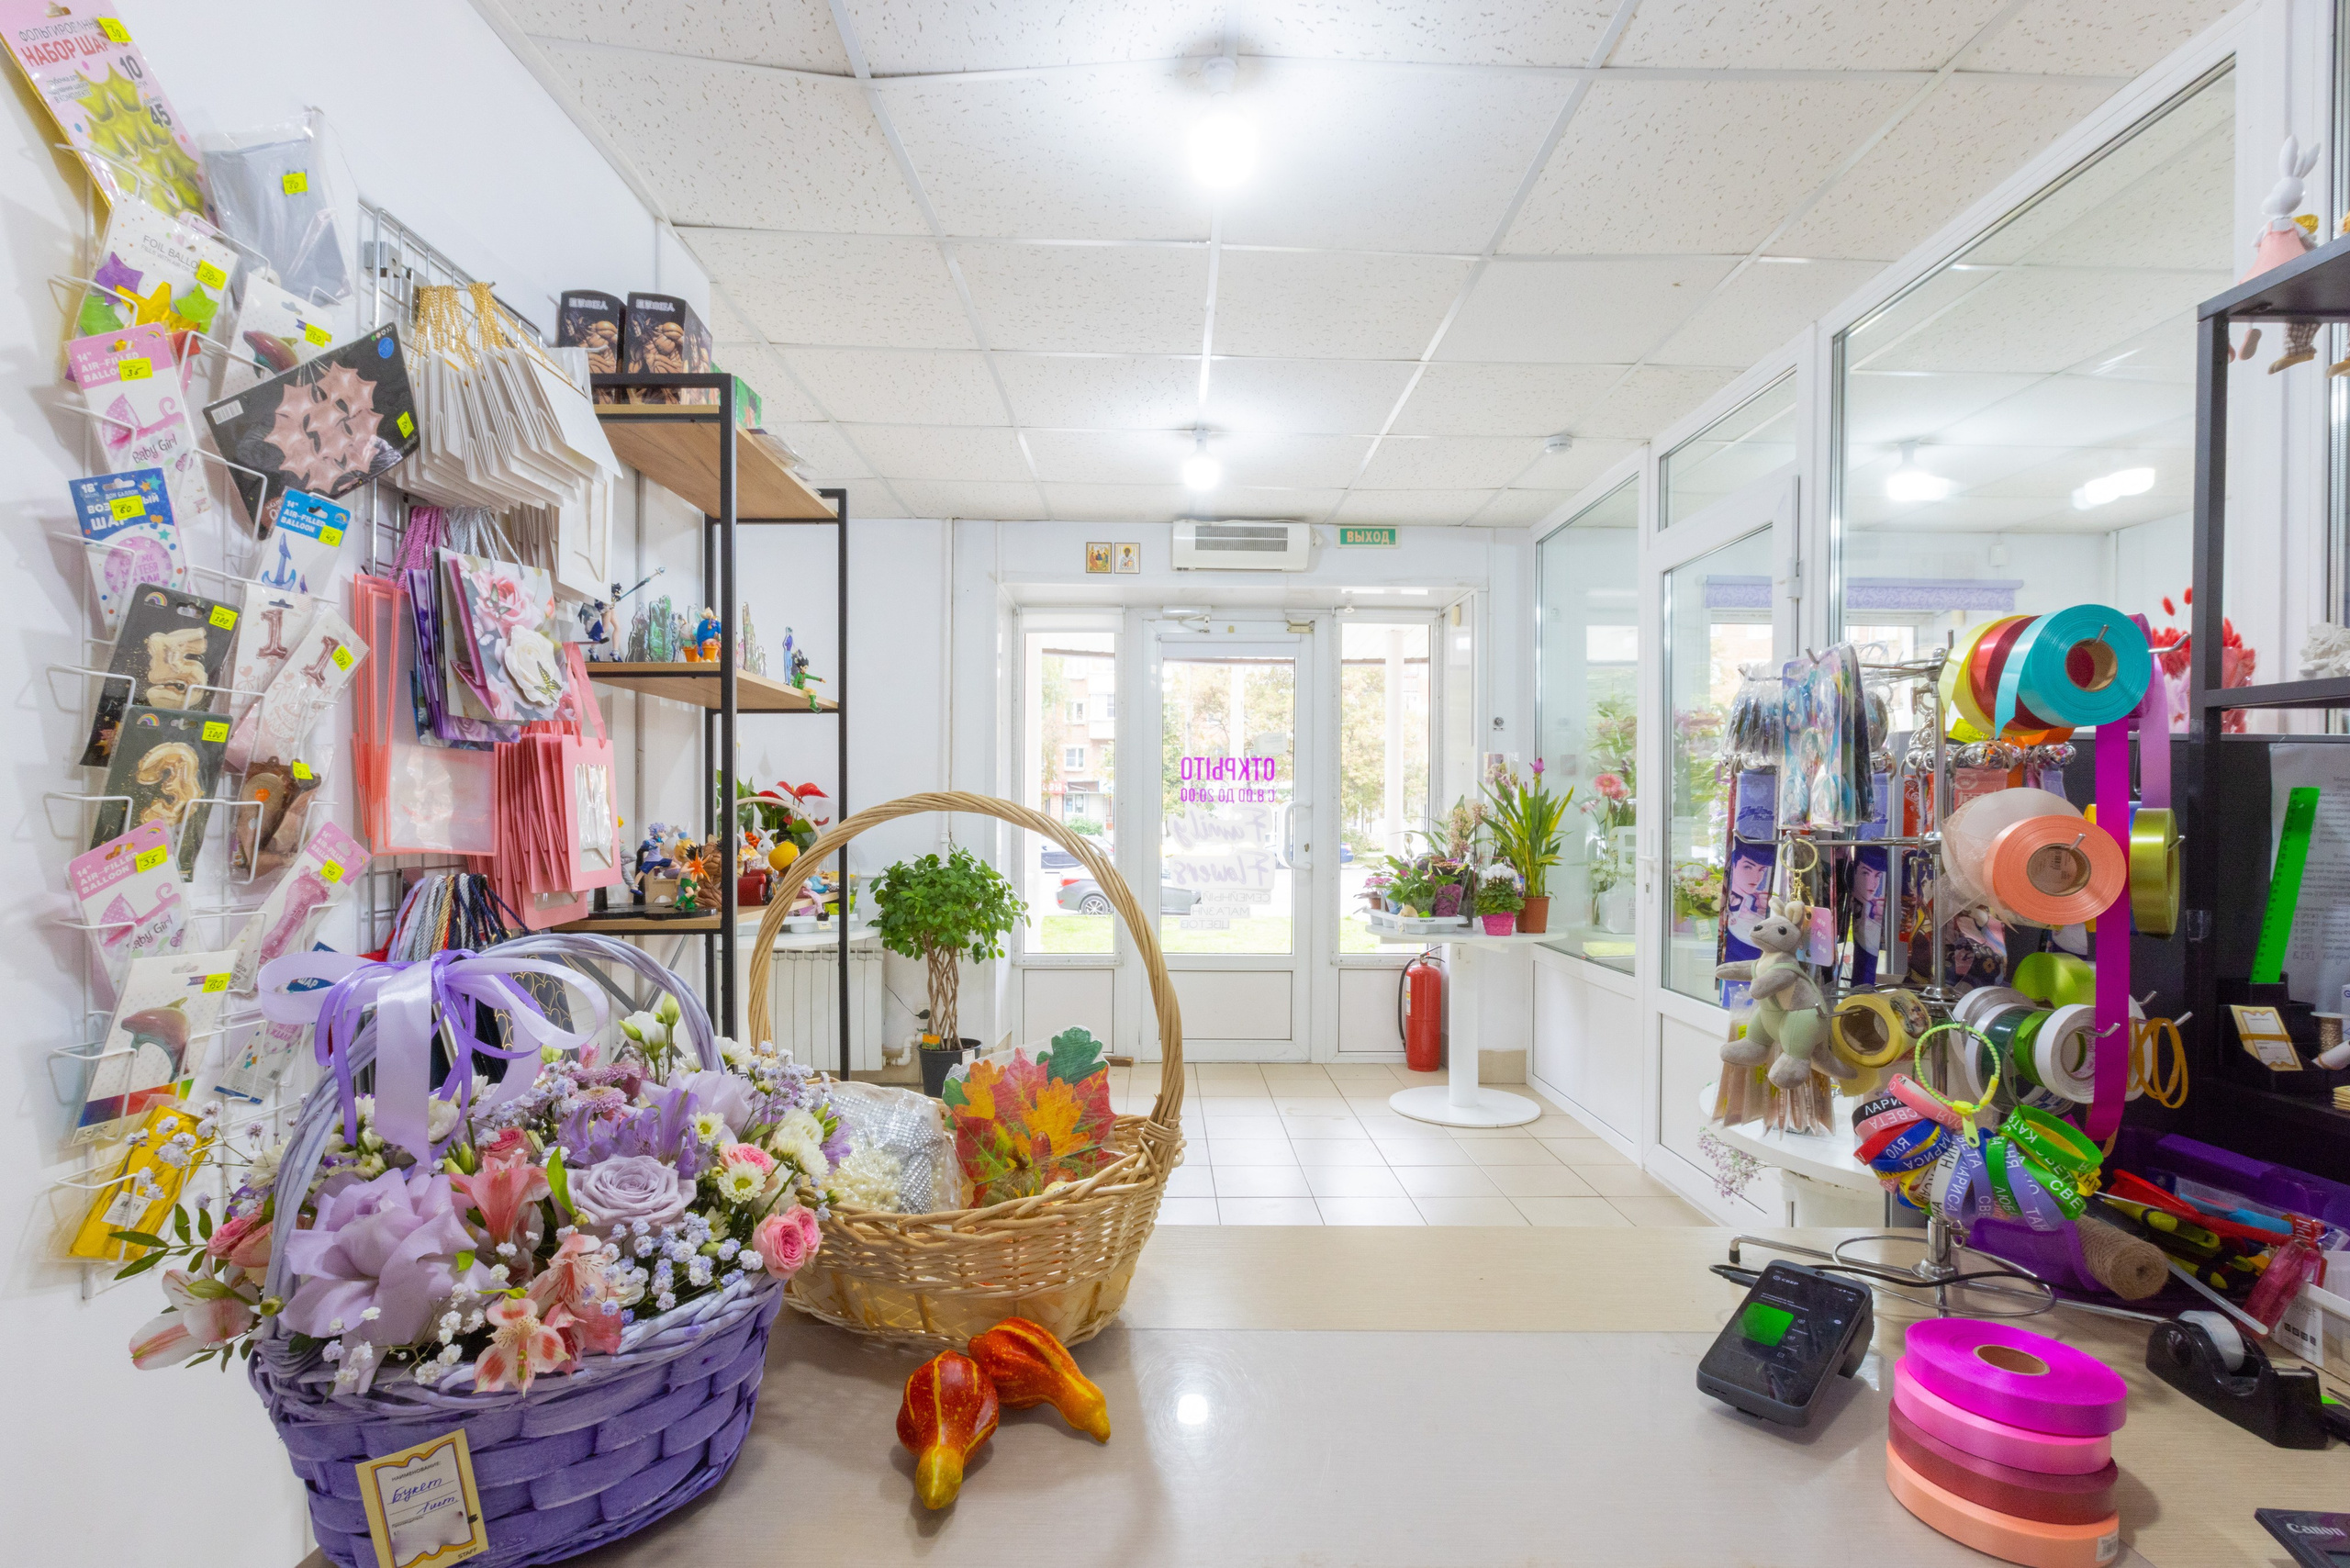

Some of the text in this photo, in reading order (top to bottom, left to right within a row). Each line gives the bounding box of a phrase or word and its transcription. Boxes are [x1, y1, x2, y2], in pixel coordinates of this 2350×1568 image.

[20, 38, 76, 68] НАБОР
[119, 54, 143, 81] 10
[150, 102, 173, 129] 45
[140, 244, 157, 256] FILLS
[156, 252, 173, 263] WITH
[142, 234, 200, 270] FOIL BALLO
[84, 365, 121, 383] BALLO
[131, 433, 178, 465] Baby Girl
[280, 516, 317, 533] BALLOON
[1346, 530, 1390, 543] ВЫХОД
[81, 865, 130, 895] BALLOON
[152, 914, 173, 935] Girl
[1869, 1107, 1919, 1130] СВЕТА
[1886, 1137, 1911, 1159] ОЛЯ
[1902, 1132, 1951, 1170] ЛАРИСА
[391, 1461, 442, 1482] НАИМЕНОВАНИЕ:
[391, 1477, 442, 1505] Букет
[2286, 1522, 2348, 1538] Canon
[457, 1546, 478, 1560] STAFF
